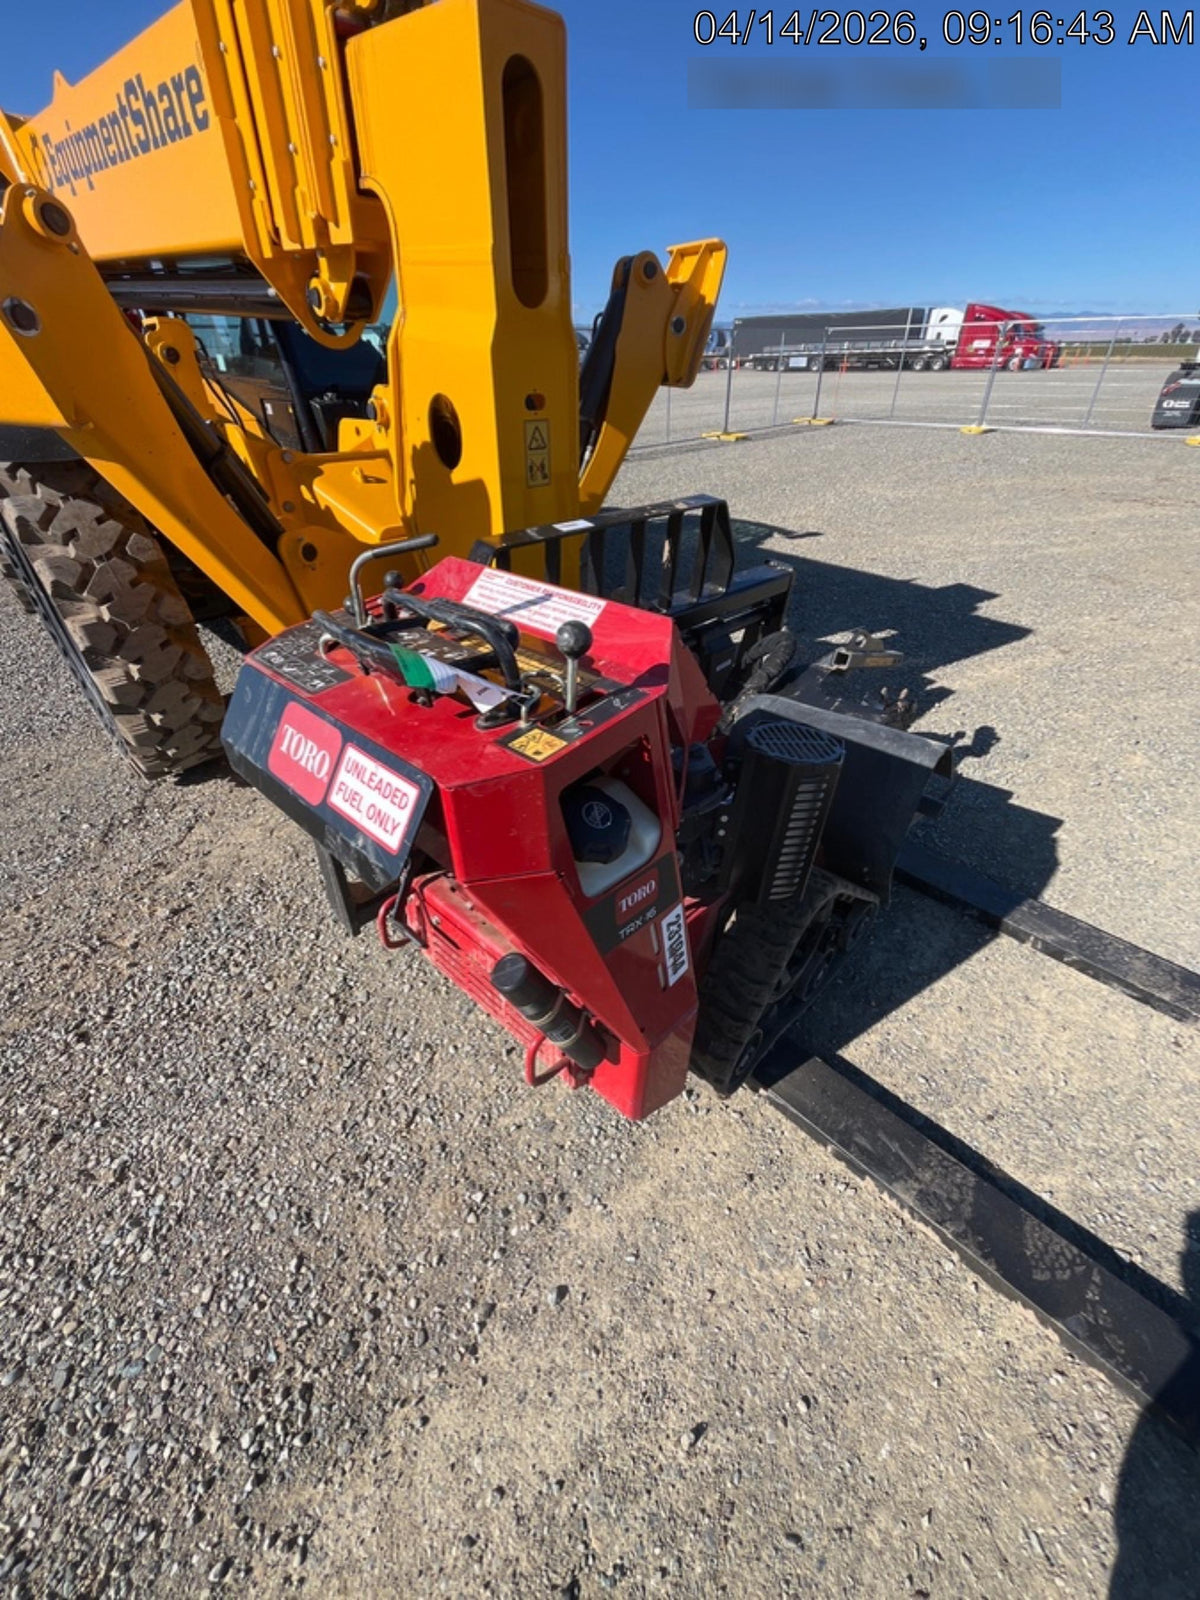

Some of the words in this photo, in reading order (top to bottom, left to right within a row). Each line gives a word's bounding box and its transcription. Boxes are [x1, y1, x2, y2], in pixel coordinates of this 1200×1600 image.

[42, 64, 209, 197] EquipmentShare
[279, 723, 331, 780] TORO
[335, 781, 364, 814] FUEL
[366, 803, 401, 837] ONLY
[344, 756, 410, 811] UNLEADED
[619, 879, 656, 913] TORO
